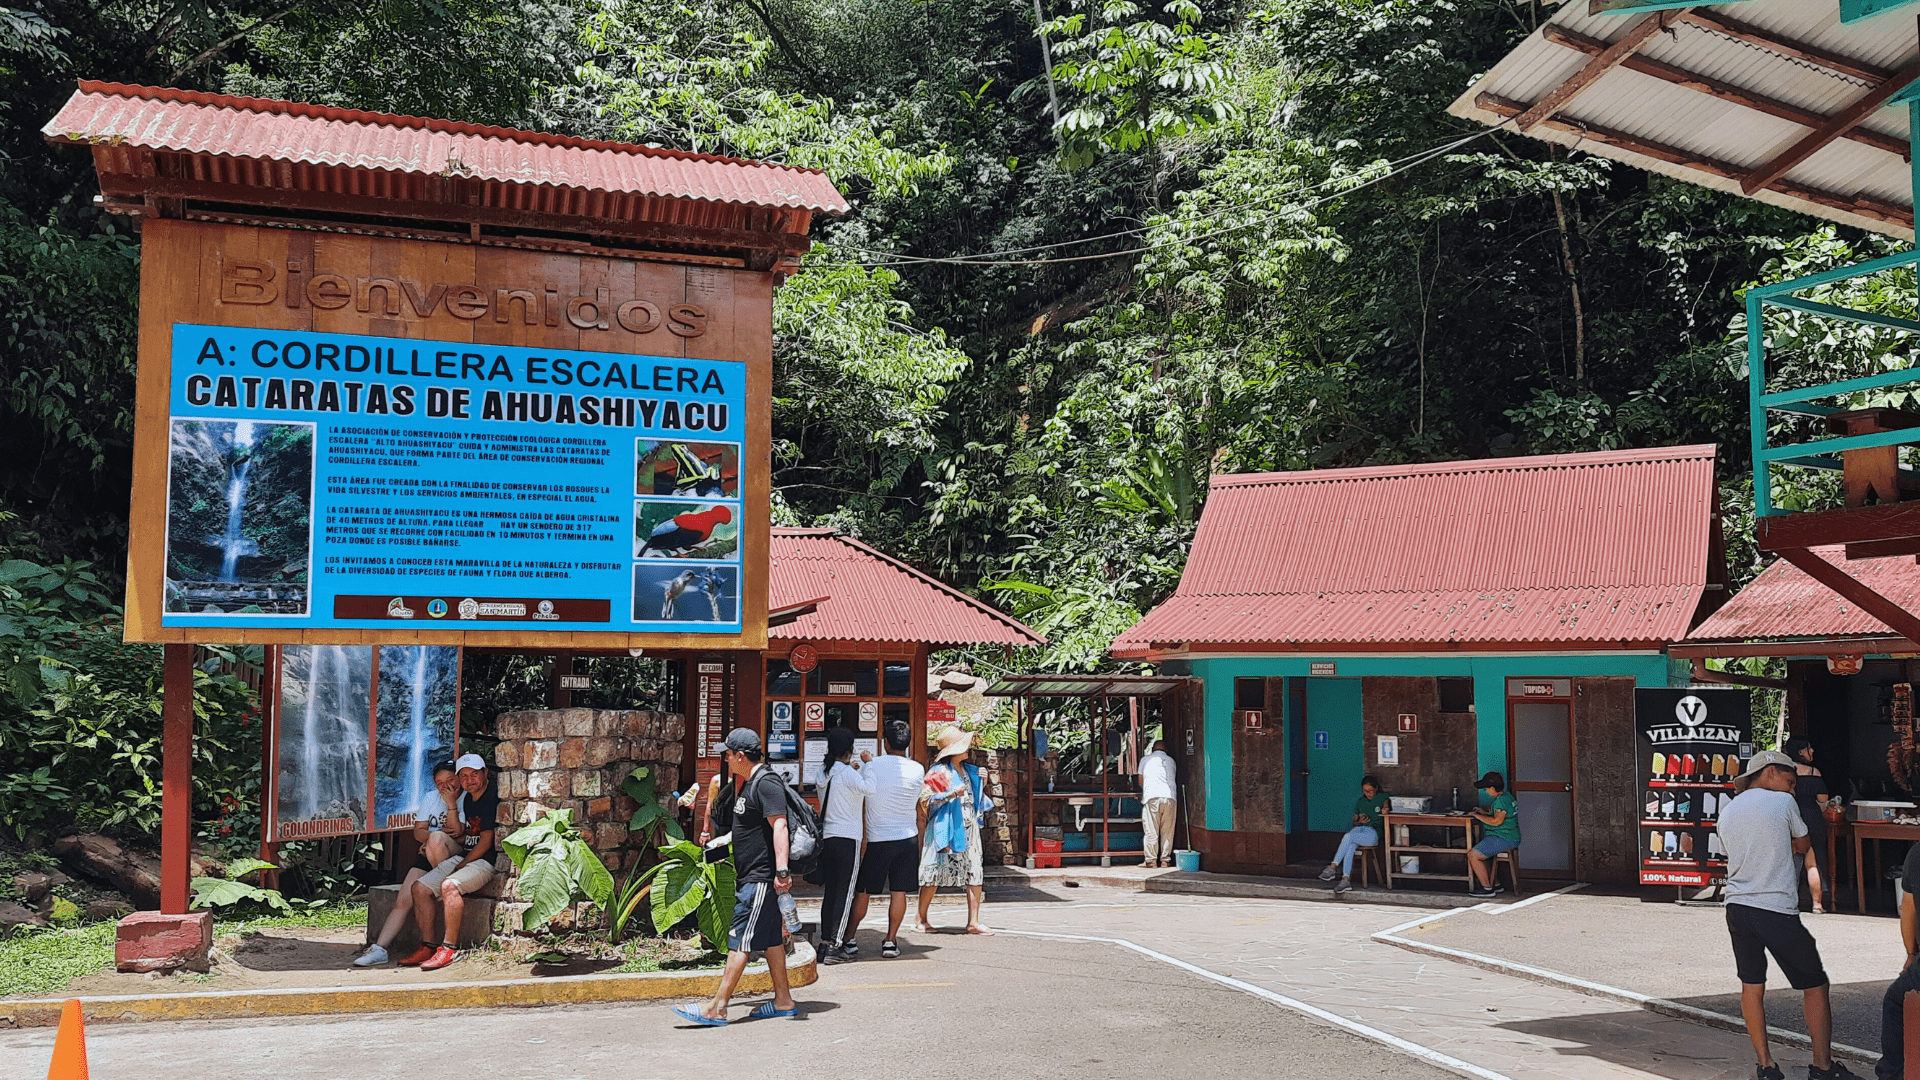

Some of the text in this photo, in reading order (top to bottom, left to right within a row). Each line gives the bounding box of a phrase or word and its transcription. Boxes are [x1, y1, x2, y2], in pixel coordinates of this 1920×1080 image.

[221, 257, 707, 338] Bienvenidos
[196, 337, 725, 395] A: CORDILLERA ESCALERA
[186, 374, 728, 432] CATARATAS DE AHUASHIYACU
[340, 426, 389, 436] ASOCIACIÓN
[402, 428, 461, 439] CONSERVACIÓN
[470, 432, 518, 442] PROTECCIÓN
[519, 434, 560, 444] ECOLÓGICA
[562, 437, 606, 446] CORDILLERA
[328, 436, 368, 444] ESCALERA
[458, 441, 481, 450] CUIDA
[491, 443, 538, 453] ADMINISTRA
[556, 446, 599, 455] CATARATAS
[328, 455, 420, 467] CORDILLERA ESCALERA.
[389, 448, 404, 456] QUE
[406, 449, 434, 457] FORMA
[436, 450, 460, 458] PARTE
[478, 451, 497, 460] ÁREA
[510, 453, 568, 463] CONSERVACIÓN
[569, 456, 604, 465] REGIONAL
[349, 475, 370, 484] ÁREA
[388, 478, 419, 486] CREADA
[450, 480, 489, 489] FINALIDAD
[502, 482, 547, 491] CONSERVAR
[565, 485, 599, 493] BOSQUES
[348, 486, 390, 495] SILVESTRE
[416, 488, 457, 497] SERVICIOS
[527, 493, 562, 501] ESPECIAL
[338, 506, 380, 514] CATARATA
[382, 507, 392, 515] DE
[394, 507, 449, 516] AHUASHIYACU
[480, 510, 517, 519] HERMOSA
[577, 514, 619, 522] CRISTALINA
[351, 516, 384, 525] METROS
[455, 519, 484, 527] LLEGAR
[529, 522, 563, 530] SENDERO
[325, 526, 359, 534] METROS
[390, 527, 425, 536] RECORRE
[427, 528, 443, 536] CON
[444, 529, 484, 537] FACILIDAD
[509, 531, 544, 539] MINUTOS
[554, 532, 586, 540] TERMINA
[325, 535, 346, 543] POZA
[348, 536, 375, 544] DONDE
[388, 537, 420, 545] POSIBLE
[422, 537, 461, 546] BAÑARSE.
[342, 556, 386, 564] INVITAMOS
[396, 557, 432, 565] CONOCER
[455, 559, 500, 567] MARAVILLA
[524, 560, 572, 569] NATURALEZA
[580, 562, 621, 570] DISFRUTAR
[348, 566, 395, 575] DIVERSIDAD
[408, 567, 445, 576] ESPECIES
[562, 676, 590, 688] ENTRADA
[829, 684, 854, 693] BOLETERIA
[1525, 685, 1545, 694] TOPICO
[1681, 703, 1701, 722] V
[1646, 727, 1741, 742] VILLAIZAN
[283, 818, 353, 838] GOLONDRINAS
[1668, 875, 1701, 883] Natural
